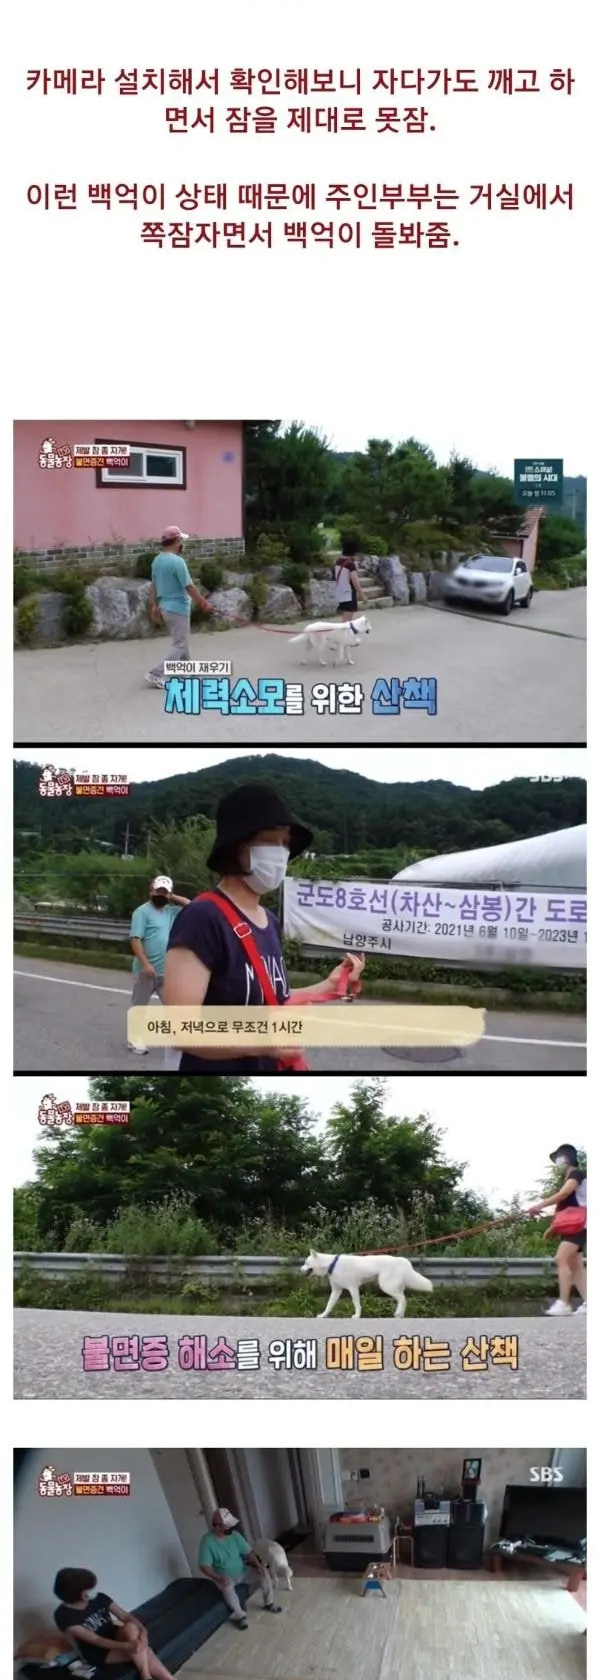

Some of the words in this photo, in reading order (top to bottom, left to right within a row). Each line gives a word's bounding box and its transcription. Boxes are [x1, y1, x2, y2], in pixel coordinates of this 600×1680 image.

[545, 899, 587, 924] 도로
[381, 918, 431, 934] 공사기간:
[434, 922, 474, 938] 2021년
[479, 925, 498, 940] 6월
[343, 933, 392, 950] 남양주시
